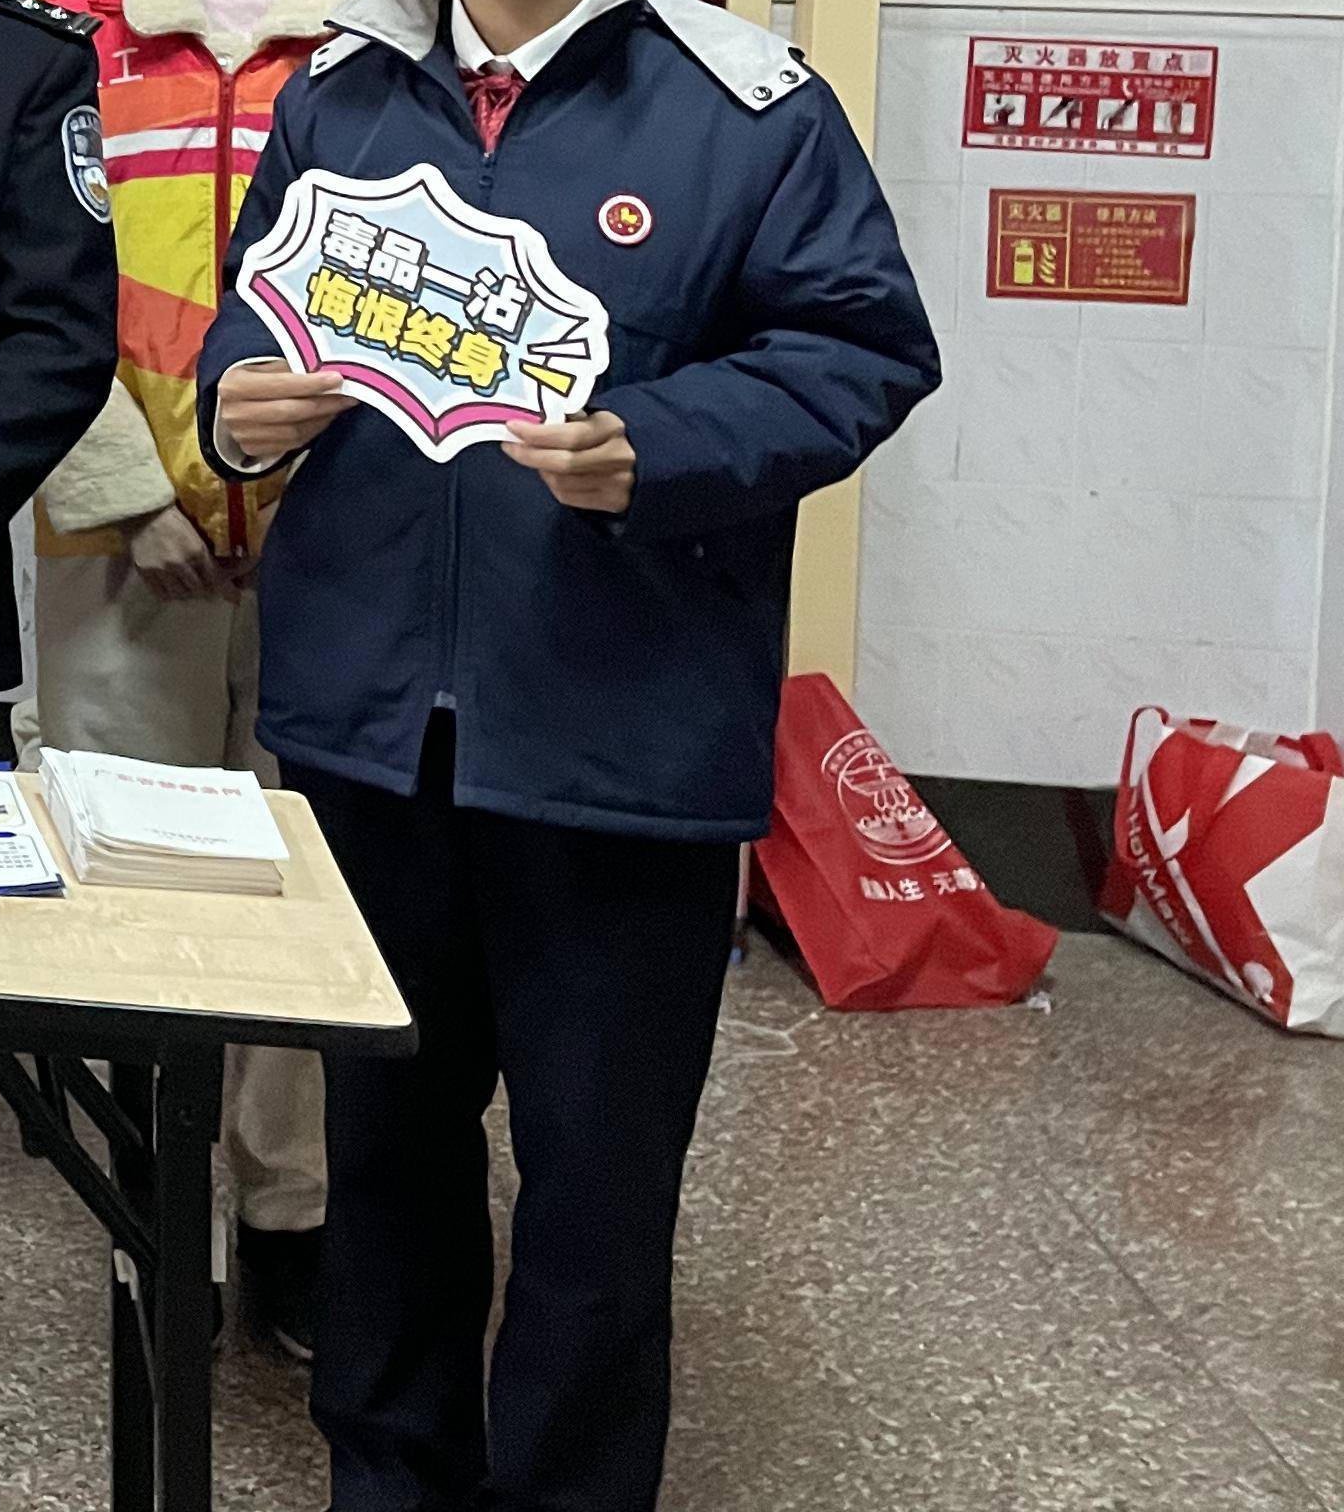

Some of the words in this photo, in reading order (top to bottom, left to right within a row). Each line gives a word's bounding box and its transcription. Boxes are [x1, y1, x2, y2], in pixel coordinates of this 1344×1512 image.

[306, 266, 511, 397] 悔恨终身
[321, 208, 535, 344] 毒品一沾
